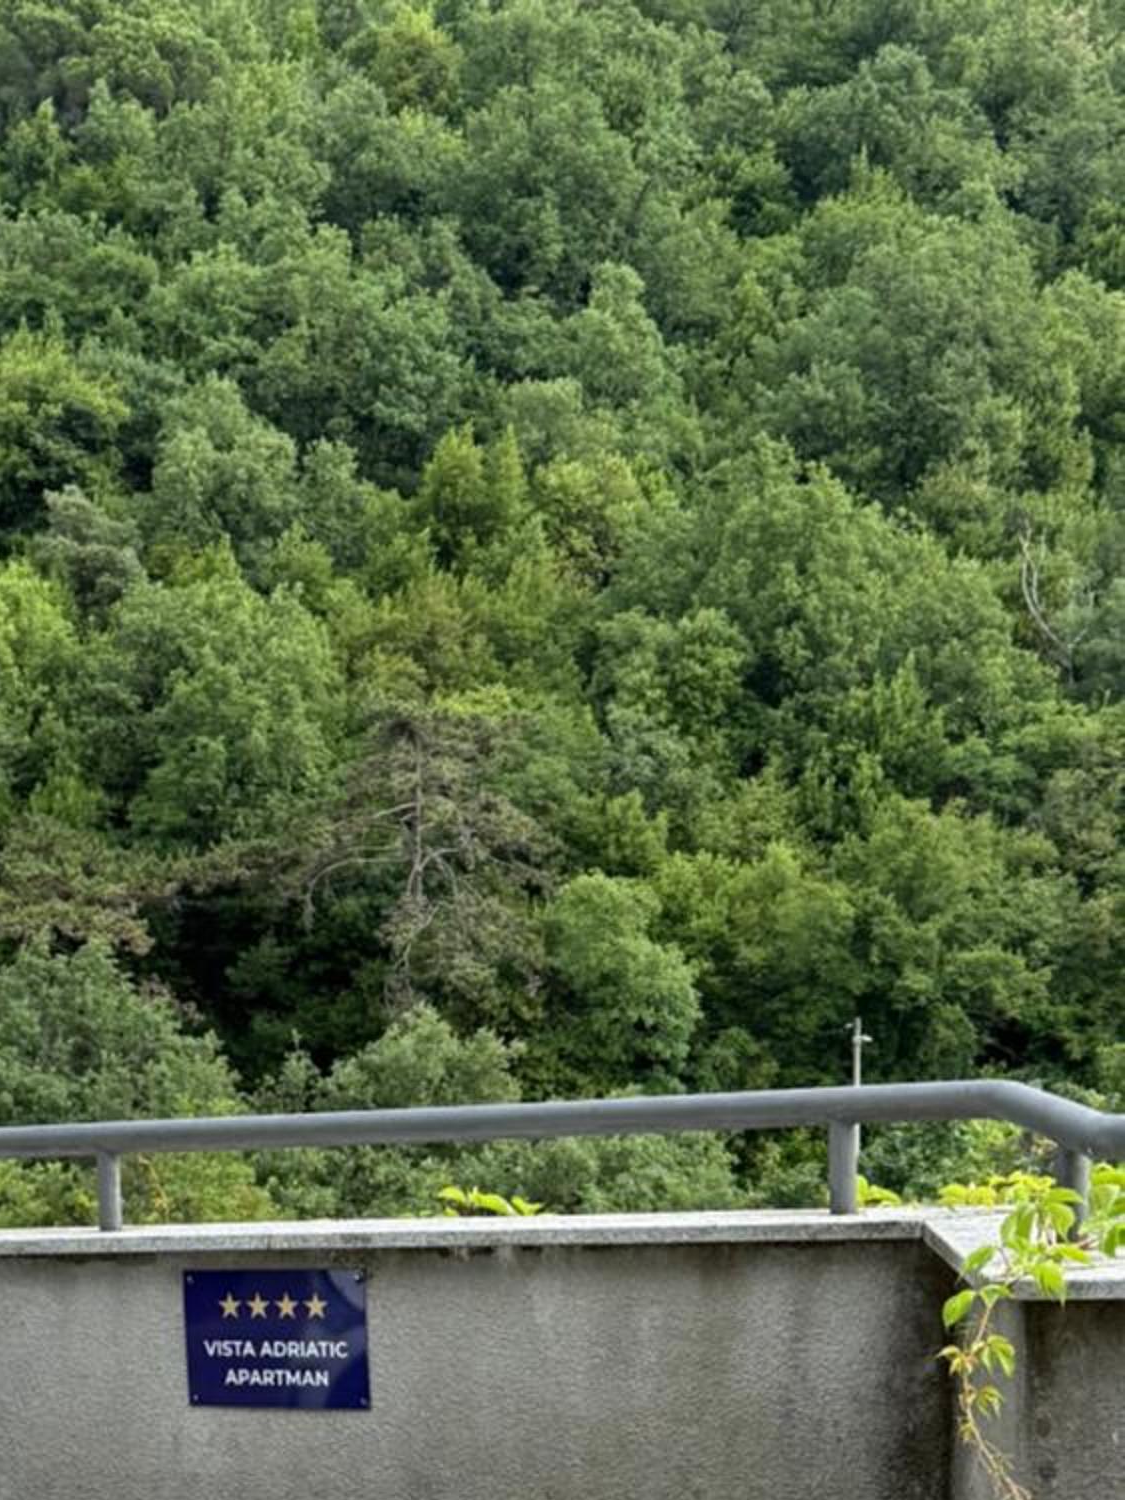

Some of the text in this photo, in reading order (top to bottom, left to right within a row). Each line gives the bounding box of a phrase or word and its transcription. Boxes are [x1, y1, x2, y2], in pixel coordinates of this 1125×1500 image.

[203, 1340, 348, 1358] VISTA ADRIATIC
[225, 1369, 329, 1386] APARTMAN
